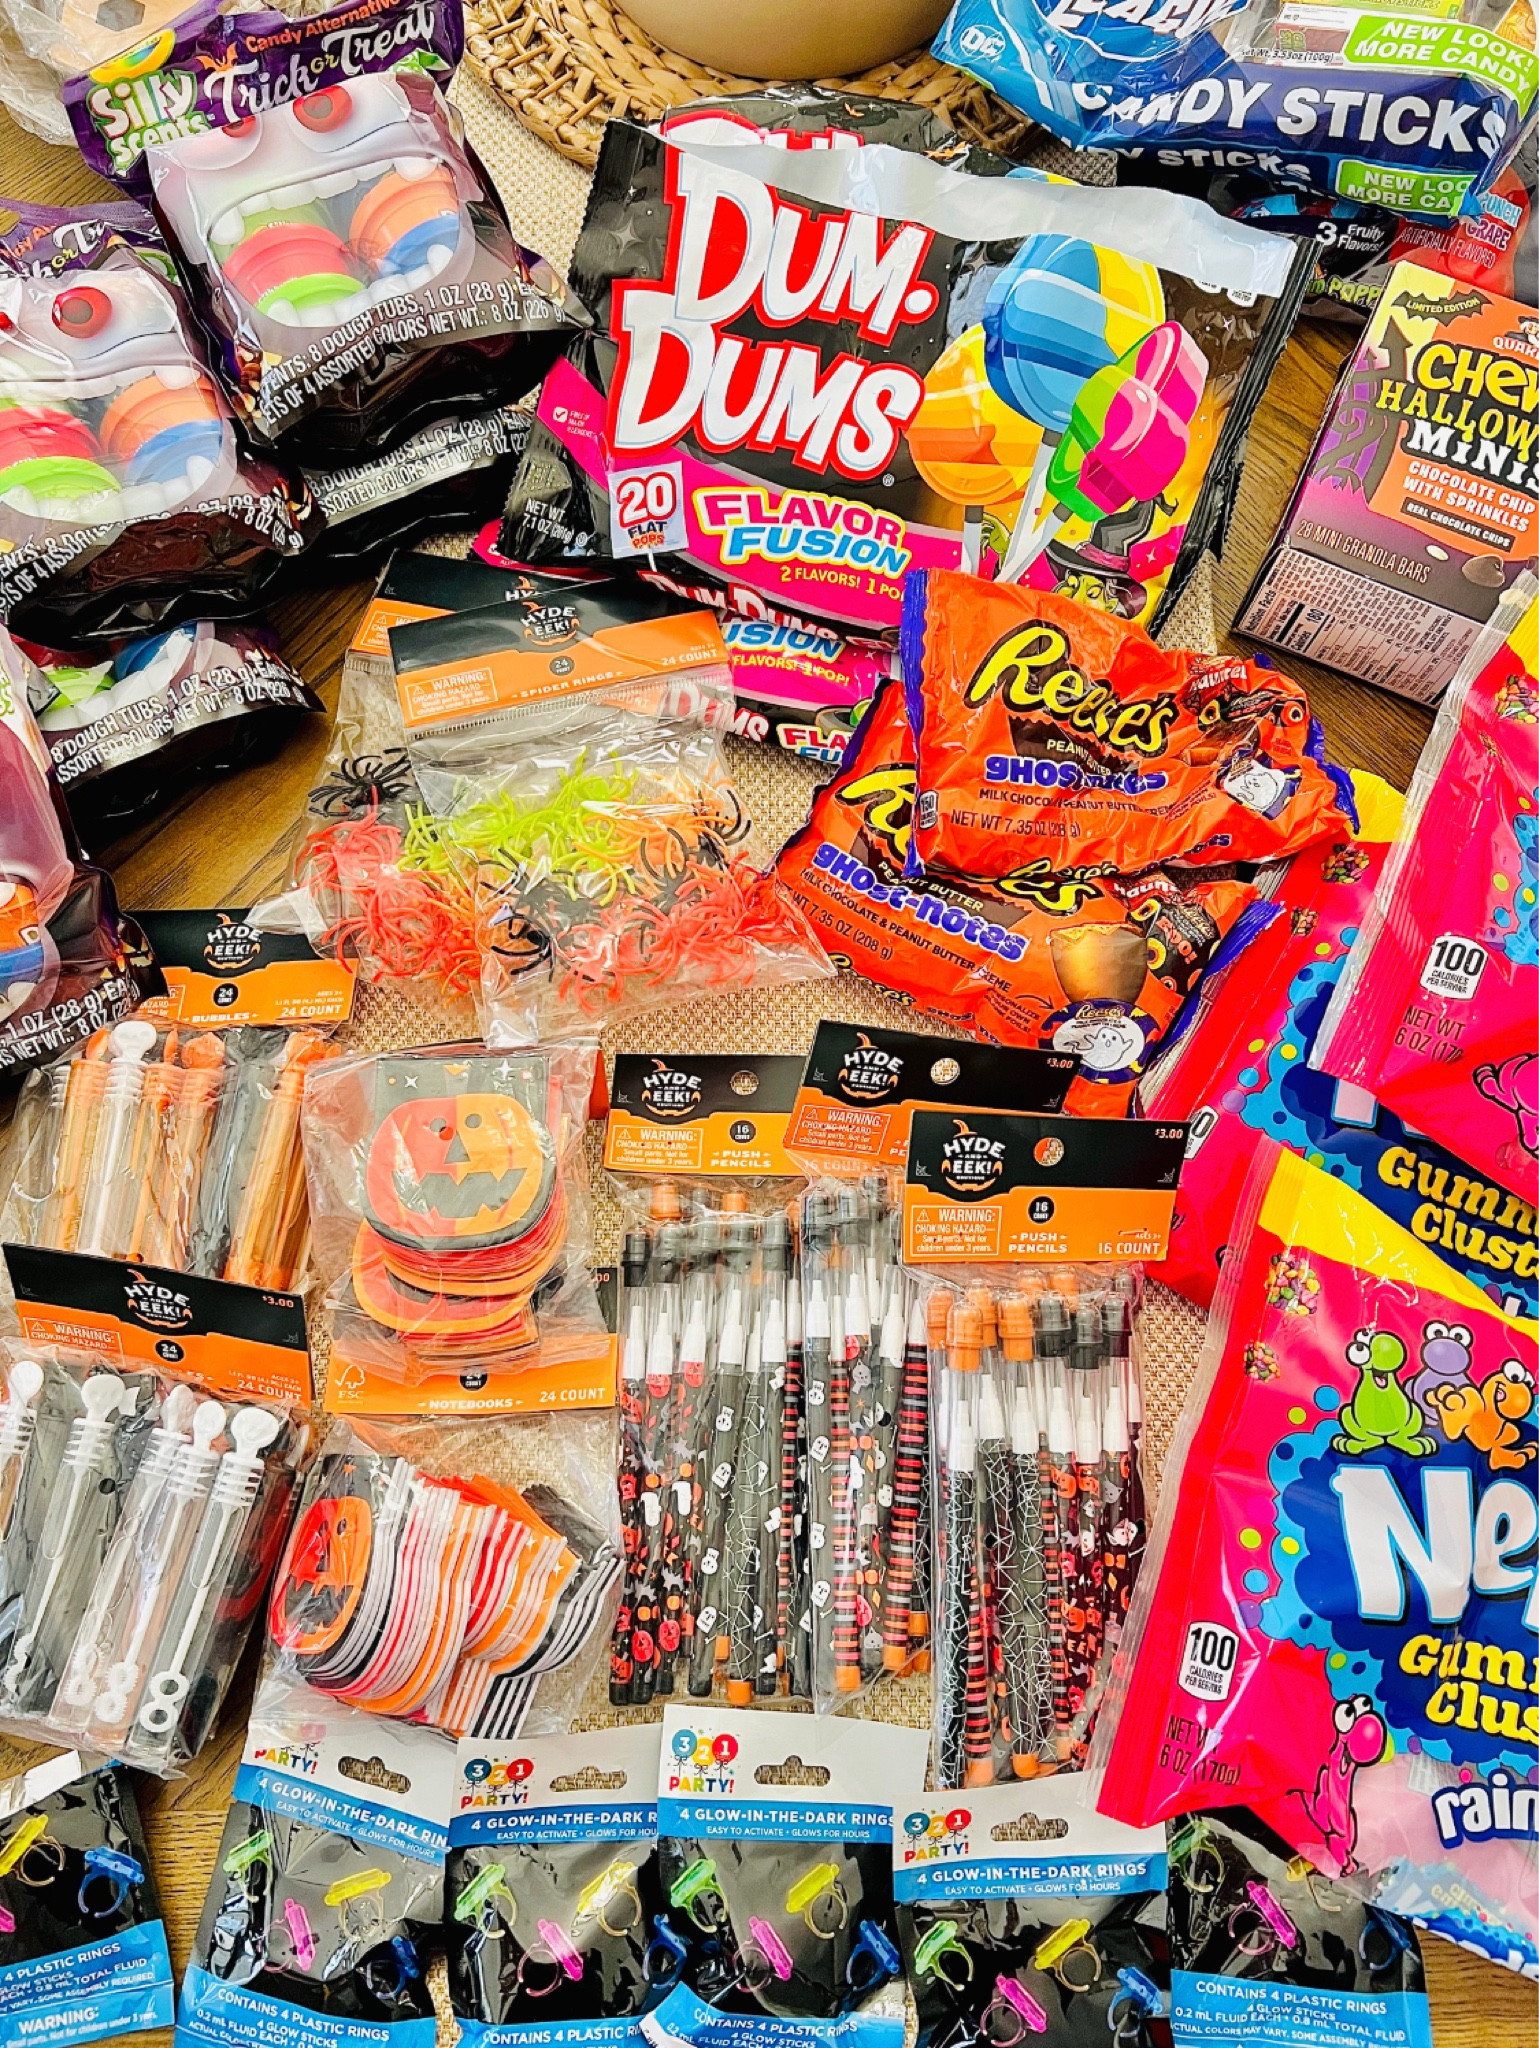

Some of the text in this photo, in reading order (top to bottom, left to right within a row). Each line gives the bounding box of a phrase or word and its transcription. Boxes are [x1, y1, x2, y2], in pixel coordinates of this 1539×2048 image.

[245, 29, 301, 53] Candy
[964, 28, 1003, 55] DC
[1382, 22, 1534, 71] NEW LOOK!
[204, 3, 434, 122] Trick Treat
[1272, 49, 1335, 63] 3.53oz (100g)
[1354, 41, 1530, 94] MORE CANDY
[91, 72, 195, 138] Silly
[1277, 87, 1507, 159] STICKS
[1159, 149, 1310, 183] STICKS
[1364, 171, 1416, 191] NEW
[1347, 184, 1412, 206] MORE
[1316, 222, 1384, 246] 3 Fruity
[1338, 237, 1383, 252] Flavors!
[1465, 220, 1510, 250] GRAPE
[1399, 225, 1495, 268] ARTIFICIALLY FLAVORED
[1406, 297, 1480, 313] LIMITED EDITION
[308, 281, 494, 361] 8 DOUGH TUBS, OZ (28
[285, 299, 549, 415] OF 4 ASSORTED COLORS NET 8 OZ (226
[614, 286, 922, 474] DUMS
[1408, 461, 1536, 514] CHOCOLATE CHIP
[616, 472, 676, 526] 20
[1403, 476, 1530, 532] WITH SPRINKLES
[526, 499, 566, 522] NET WT
[700, 492, 903, 546] FLAVOR
[522, 514, 551, 534] 7.1 OZ
[627, 520, 668, 538] FLAT
[1406, 502, 1511, 547] REAL CHOCOLATE CHIPS
[632, 534, 664, 549] POPS
[722, 525, 909, 574] FUSION
[1296, 520, 1432, 585] 28 MINI GRANOLA BARS
[781, 566, 861, 589] 2 FLAVORS!
[521, 606, 577, 629] HYDE
[534, 621, 569, 637] EEK!
[661, 649, 718, 666] 24 COUNT
[432, 672, 487, 691] WARNING:
[521, 672, 614, 697] SPIDER RINGS
[814, 667, 850, 684] POP!
[970, 626, 1179, 752] Reese's
[980, 790, 1008, 803] MILK
[951, 809, 1033, 834] NET WT 7.35
[928, 882, 984, 913] BUTTER
[208, 926, 262, 943] HYDE
[809, 904, 878, 952] 7.35 OZ (208
[822, 881, 976, 972] CHOCOLATE PEANUT BUTTER
[214, 944, 249, 957] EEK!
[1435, 941, 1487, 977] 100
[1431, 970, 1469, 988] CALORIES
[192, 1012, 250, 1023] BUBBLES
[281, 1004, 341, 1017] 24 COUNT
[1403, 1006, 1466, 1041] NET WT
[1395, 1027, 1432, 1053] 6 OZ
[844, 1050, 904, 1073] HYDE
[1046, 1057, 1074, 1070] $3.00
[850, 1072, 889, 1087] EEK!
[827, 1112, 883, 1128] WARNING:
[640, 1129, 697, 1142] WARNING:
[1154, 1128, 1183, 1140] $3.00
[722, 1150, 760, 1158] PUSH
[944, 1136, 1005, 1159] HYDE
[710, 1159, 771, 1168] PENCILS
[938, 1208, 996, 1222] WARNING:
[915, 1224, 950, 1235] CHOKING
[1020, 1233, 1057, 1241] PUSH
[1009, 1244, 1067, 1253] PENCILS
[1098, 1242, 1160, 1255] 16 COUNT
[262, 1295, 294, 1309] $3.00
[53, 1323, 115, 1343] WARNING:
[238, 1379, 254, 1391] 24
[258, 1384, 302, 1401] COUNT
[540, 1388, 605, 1402] 24 COUNT
[429, 1398, 513, 1409] NOTEBOOKS
[1332, 1466, 1539, 1630] Ne
[1190, 1627, 1235, 1671] 100
[1168, 1715, 1196, 1743] NET
[1161, 1745, 1241, 1786] 6 OZ (170g)
[669, 1776, 734, 1793] PARTY!
[460, 1790, 527, 1809] PARTY!
[695, 1810, 846, 1824] GLOW-IN-THE-DARK
[706, 1826, 870, 1839] EASY ACTIVATE GLOWS HOURS
[904, 1842, 969, 1863] PARTY!
[932, 1863, 1147, 1882] GLOW-IN-THE-DARK RINGS
[1196, 1981, 1386, 2015] CONTAINS PLASTIC RINGS
[18, 2006, 100, 2035] WARNING:
[1256, 2004, 1336, 2020] GLOW STICKS
[1175, 2007, 1406, 2041] 0.2 FLUID EACH TOTAL FLUID
